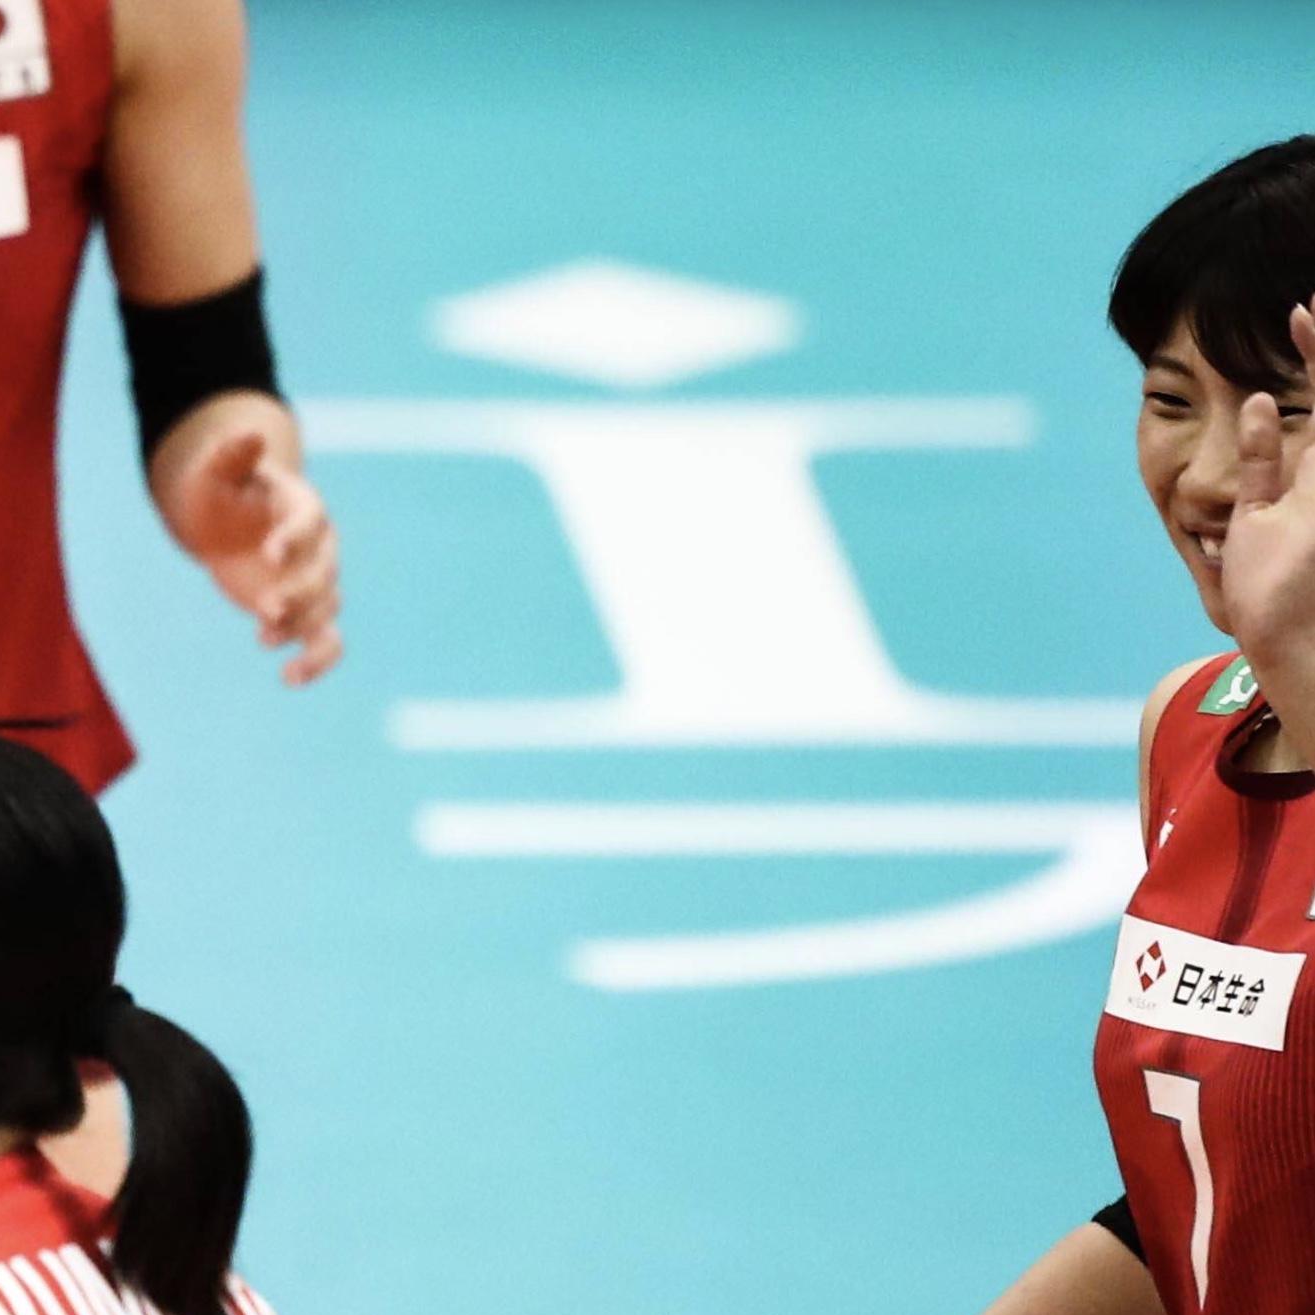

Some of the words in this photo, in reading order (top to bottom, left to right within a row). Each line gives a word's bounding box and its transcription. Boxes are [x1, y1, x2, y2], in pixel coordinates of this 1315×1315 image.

[1173, 963, 1265, 1015] 日本生命
[1142, 1069, 1214, 1311] 7
